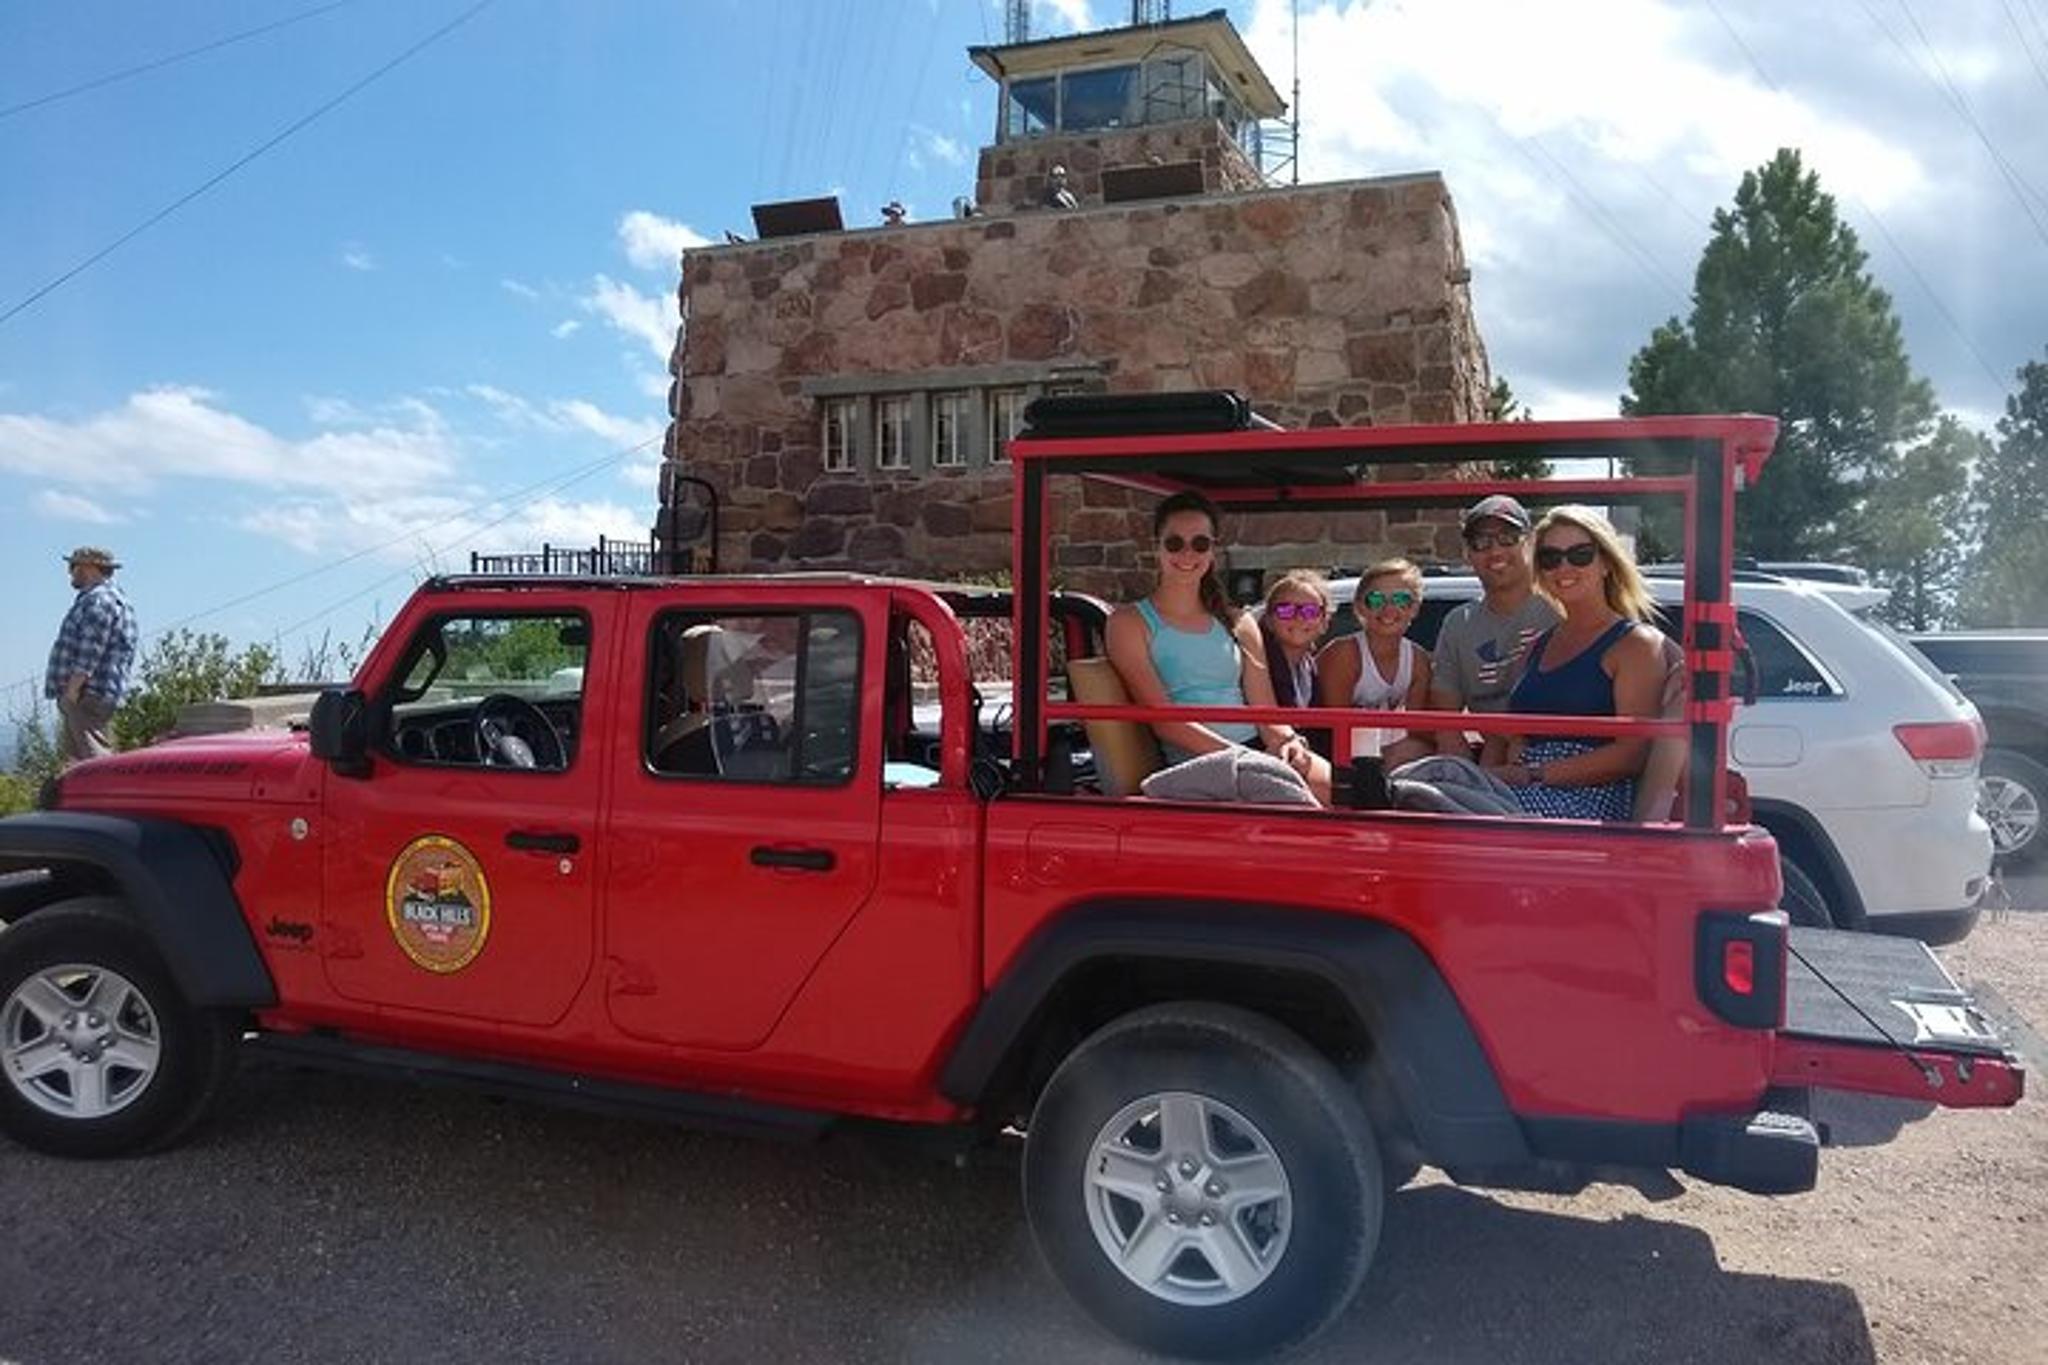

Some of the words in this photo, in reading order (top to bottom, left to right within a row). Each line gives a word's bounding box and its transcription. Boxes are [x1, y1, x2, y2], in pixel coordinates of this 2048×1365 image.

[1783, 679, 1823, 695] Jeep
[404, 901, 439, 921] BLACK
[440, 904, 472, 926] HILLS
[265, 915, 314, 944] Jeep
